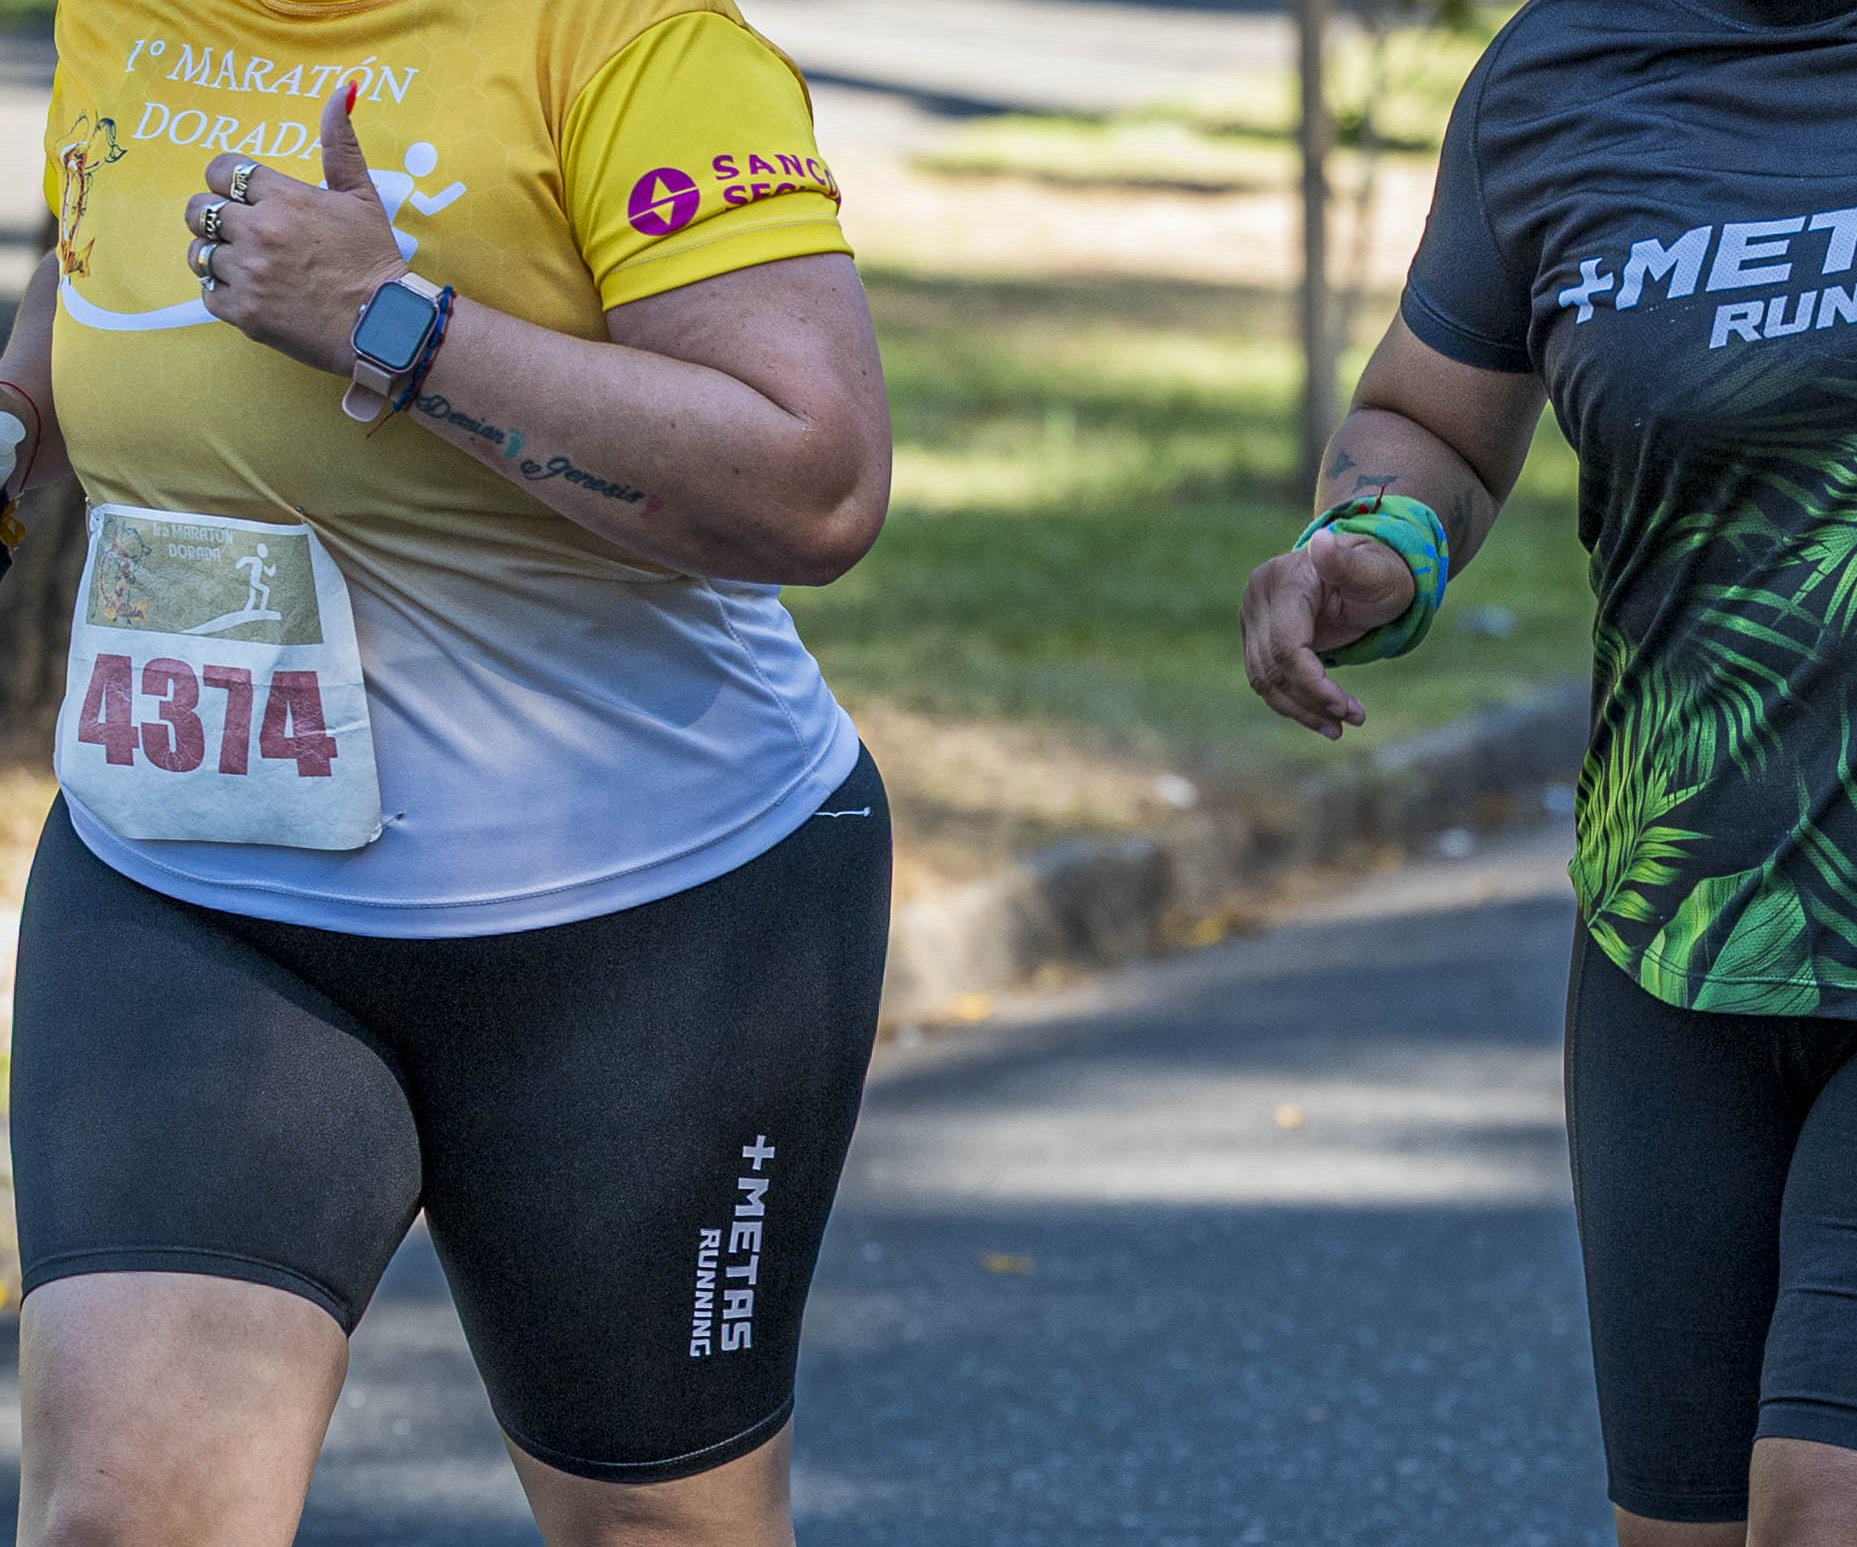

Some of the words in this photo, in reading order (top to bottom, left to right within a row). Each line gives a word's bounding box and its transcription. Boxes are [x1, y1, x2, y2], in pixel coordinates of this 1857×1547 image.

[166, 44, 419, 104] MARATÓN
[78, 653, 339, 778] 4374
[689, 1228, 722, 1357] RUNNING
